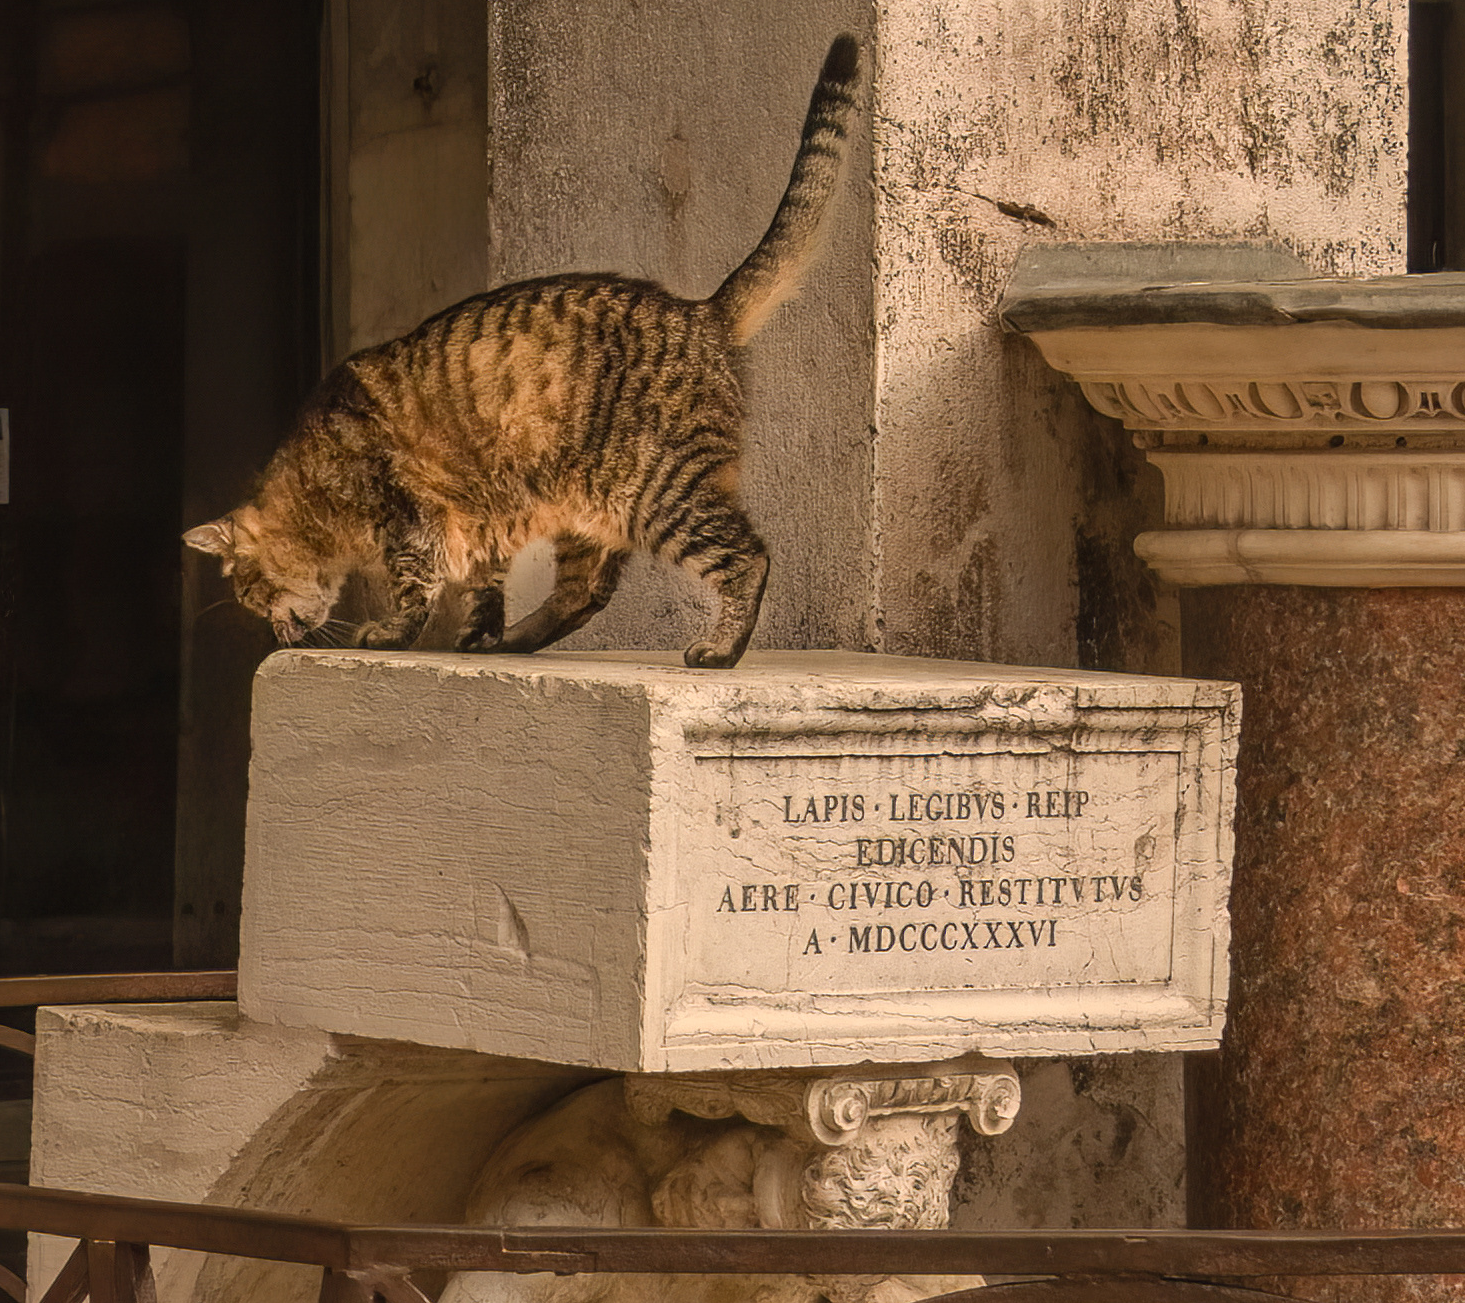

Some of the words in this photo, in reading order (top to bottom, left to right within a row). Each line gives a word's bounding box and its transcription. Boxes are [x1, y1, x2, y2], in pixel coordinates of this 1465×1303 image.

[782, 794, 866, 824] LAPIS
[888, 793, 1005, 821] LEGIBVS
[1025, 791, 1089, 819] REIP
[857, 836, 1016, 867] EDICENDIS
[717, 884, 800, 913] AERE
[828, 880, 934, 910] CIVICO
[958, 875, 1143, 907] RESTITVTVS
[803, 927, 823, 955] A
[848, 919, 1058, 954] MDCCCXXXVI
